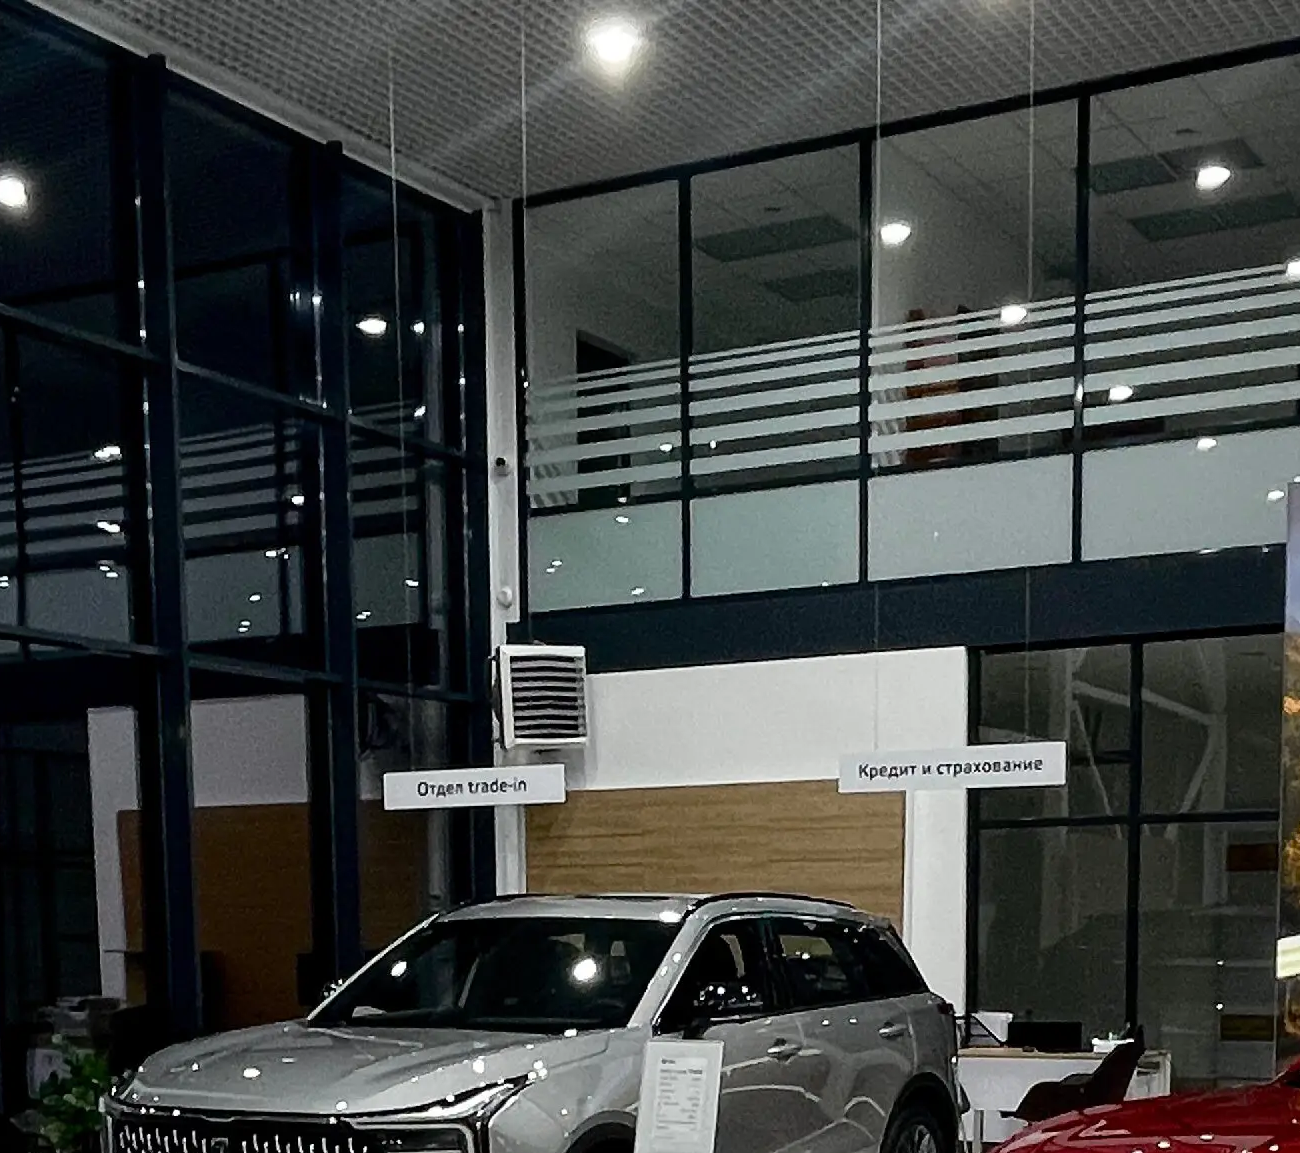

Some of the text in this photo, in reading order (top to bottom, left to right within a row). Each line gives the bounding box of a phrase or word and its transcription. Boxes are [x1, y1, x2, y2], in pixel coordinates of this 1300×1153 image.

[858, 759, 1044, 780] Кредит и страхование
[417, 777, 527, 797] Отдел trade-in
